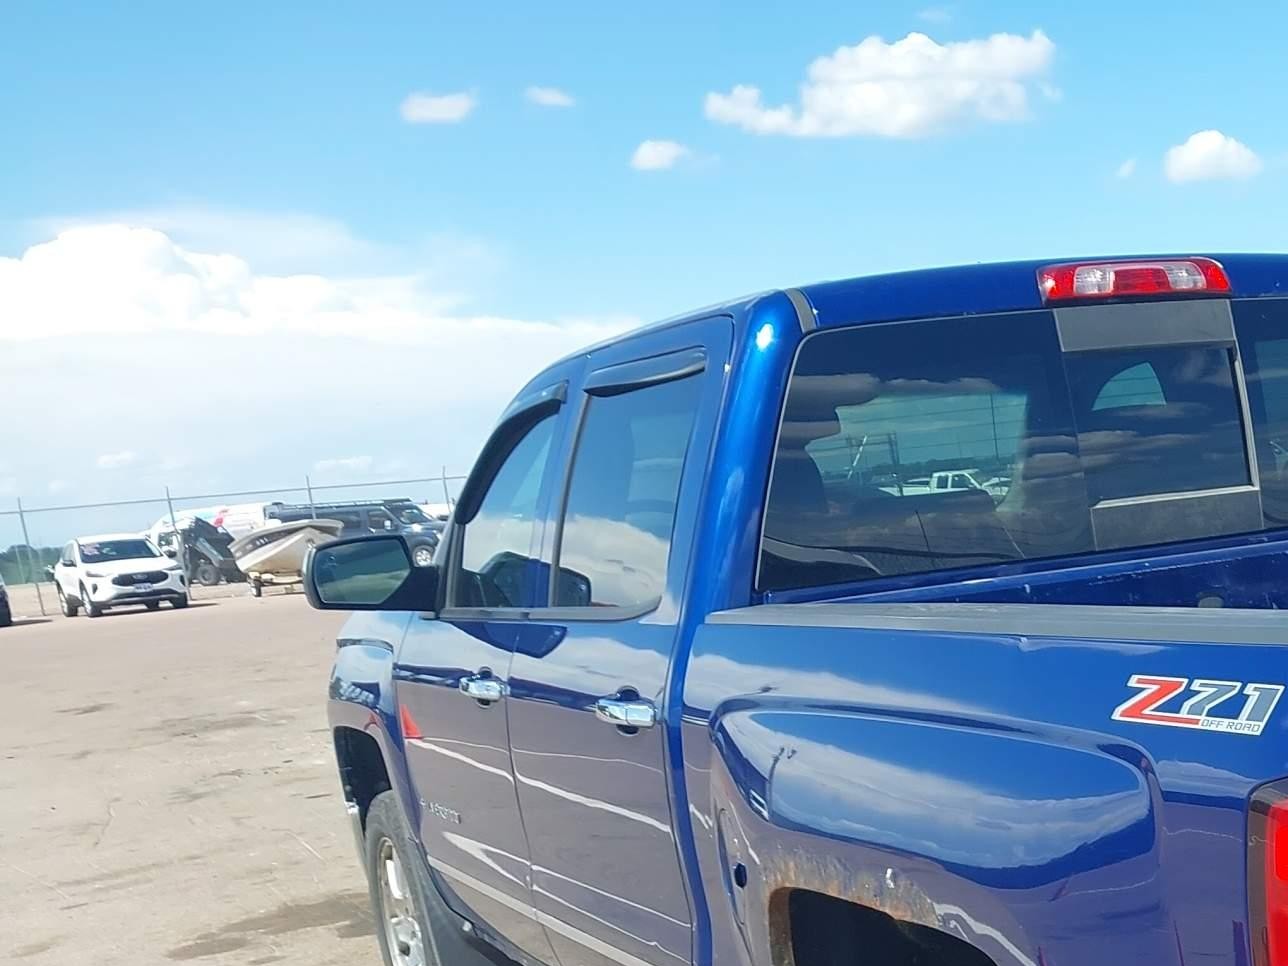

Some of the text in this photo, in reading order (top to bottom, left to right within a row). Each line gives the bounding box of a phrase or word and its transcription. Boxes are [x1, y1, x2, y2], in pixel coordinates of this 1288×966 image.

[1111, 674, 1285, 733] Z71
[1200, 719, 1261, 733] OFF ROAD
